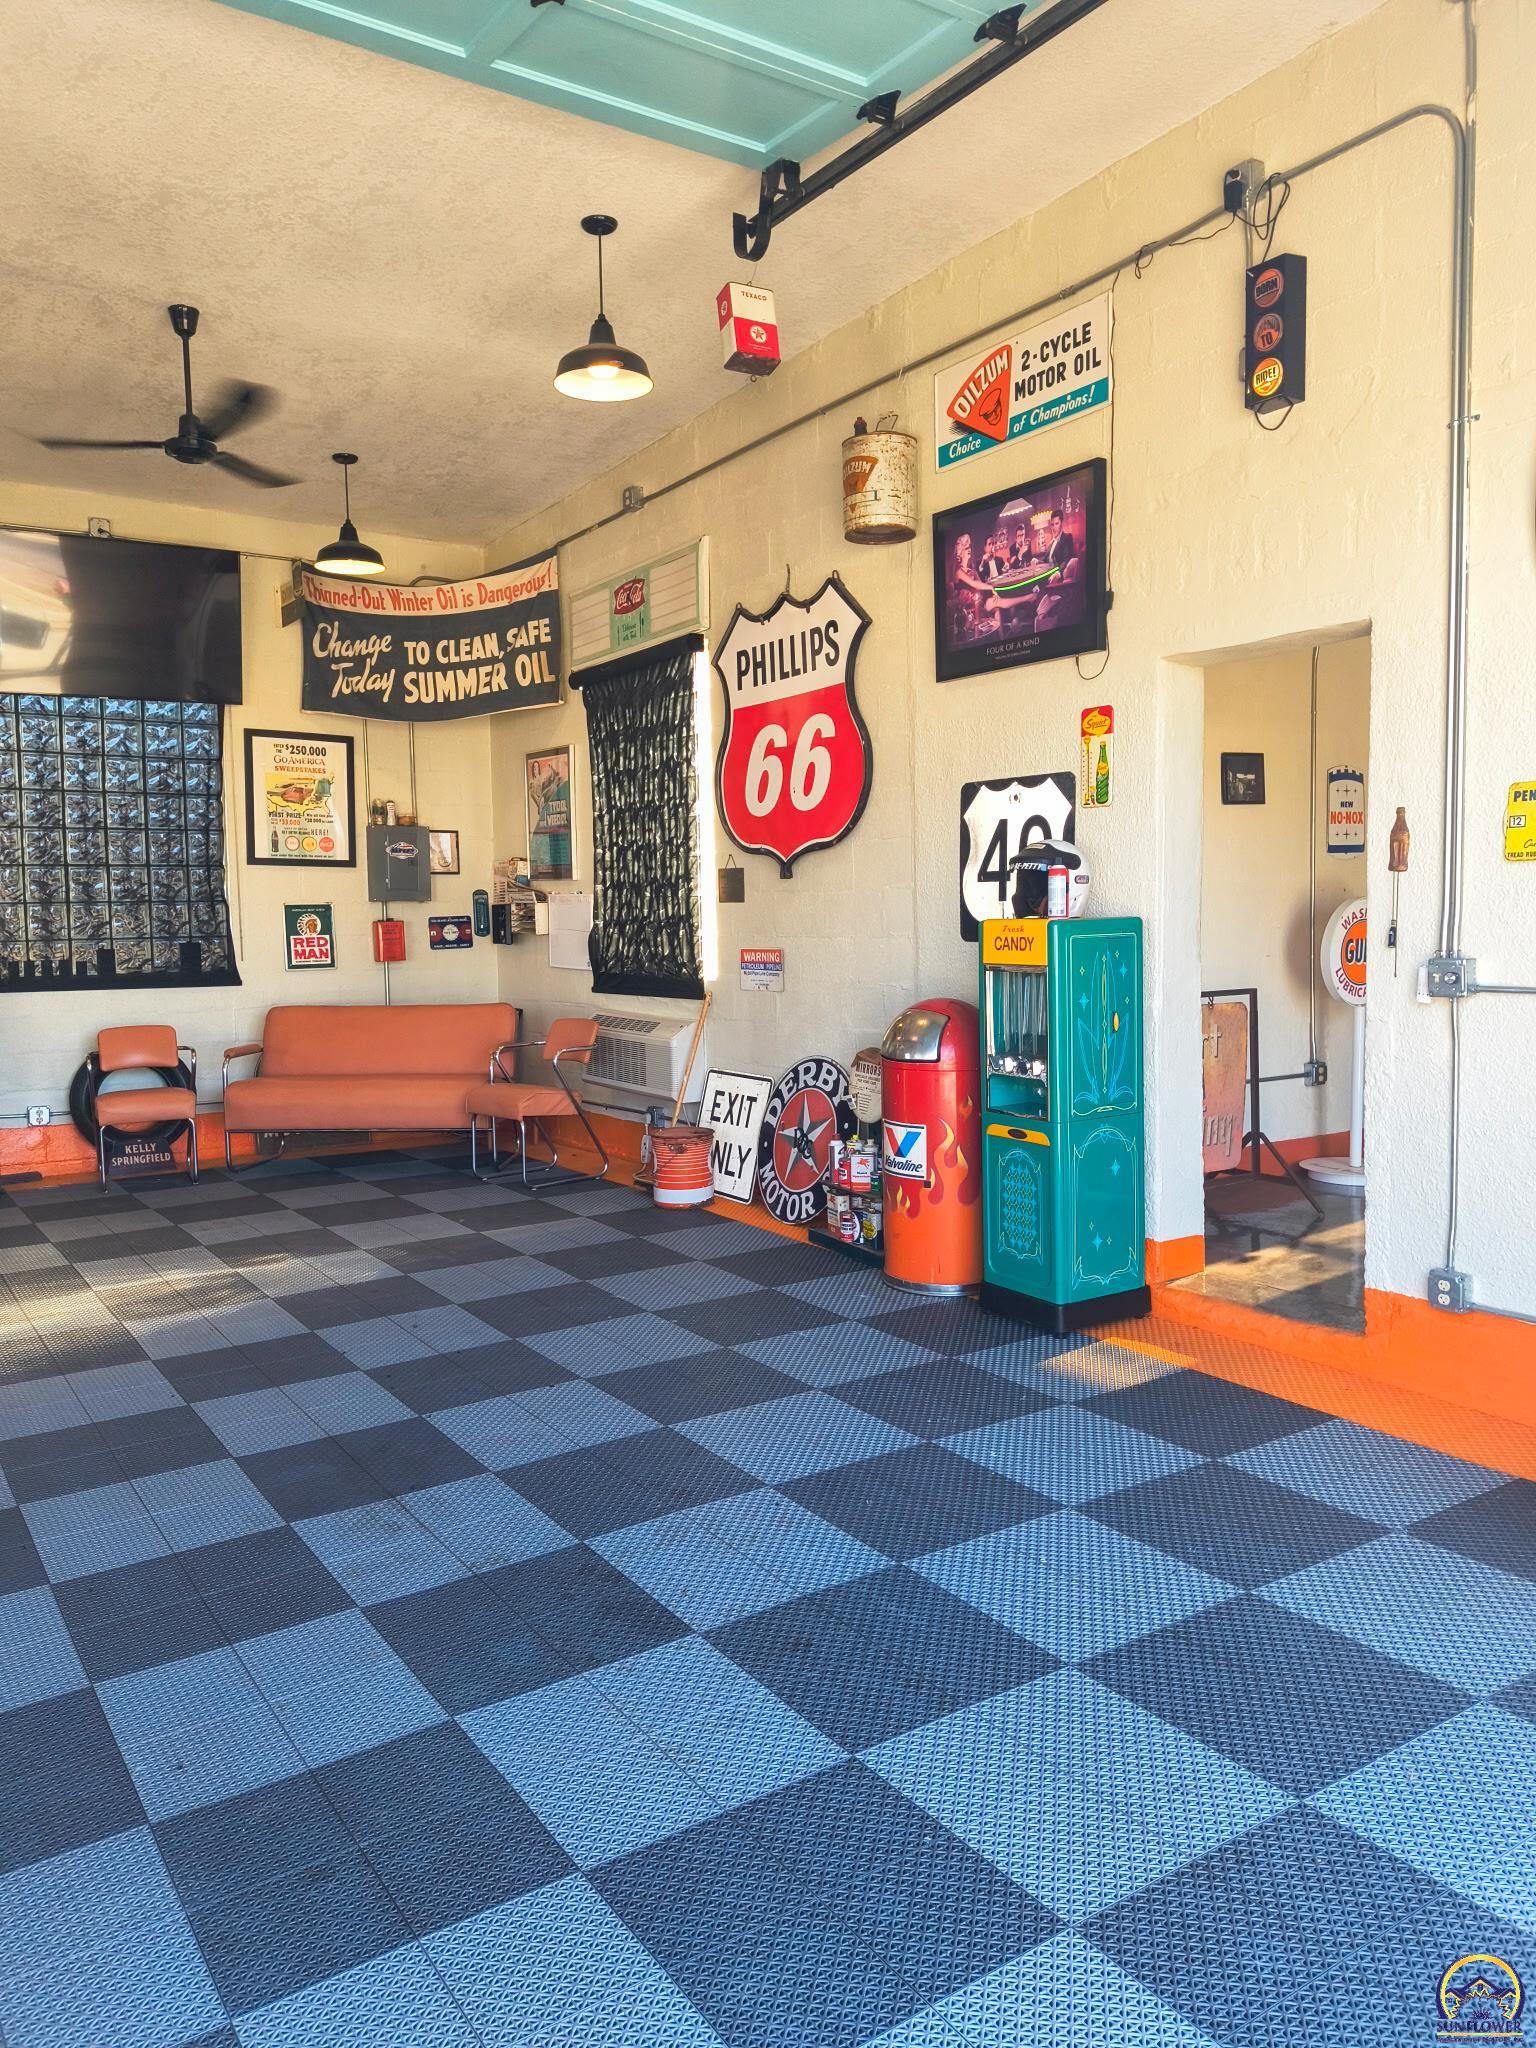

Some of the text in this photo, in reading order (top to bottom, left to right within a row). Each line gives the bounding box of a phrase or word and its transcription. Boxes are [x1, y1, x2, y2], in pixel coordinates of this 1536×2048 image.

[741, 291, 767, 301] TEXACO
[1021, 321, 1091, 372] 2-CYCLE
[1261, 331, 1273, 347] TO
[1014, 347, 1101, 402] MOTOR OIL
[1255, 367, 1276, 385] RIDE!
[953, 349, 1009, 419] OILZUM
[949, 384, 1095, 458] Choice of Champions!
[387, 588, 433, 612] Winter
[436, 587, 458, 610] Oil
[462, 590, 473, 607] is
[477, 559, 553, 606] Dangerous!
[312, 617, 552, 666] Change TO CLEAN, SAFE
[986, 646, 1004, 655] FOUR
[1005, 642, 1014, 651] OF
[1023, 637, 1040, 648] KIND
[736, 619, 840, 691] PHILLIPS
[331, 650, 557, 704] Today SUMMER OIL
[745, 713, 836, 817] 66
[1330, 811, 1363, 825] NO-NOX
[1512, 816, 1522, 826] 12
[292, 936, 329, 948] RED
[994, 936, 1034, 951] CANDY
[294, 948, 329, 960] MAN
[743, 952, 780, 962] WARNING
[856, 1062, 881, 1077] MIRRORS
[764, 1061, 850, 1128] DERBY
[710, 1089, 757, 1128] EXIT
[125, 1143, 156, 1154] KELLY
[112, 1153, 170, 1167] SPRINGFIELD
[711, 1140, 752, 1179] NLY
[885, 1155, 923, 1172] Valvoline
[760, 1159, 816, 1221] MOTOR
